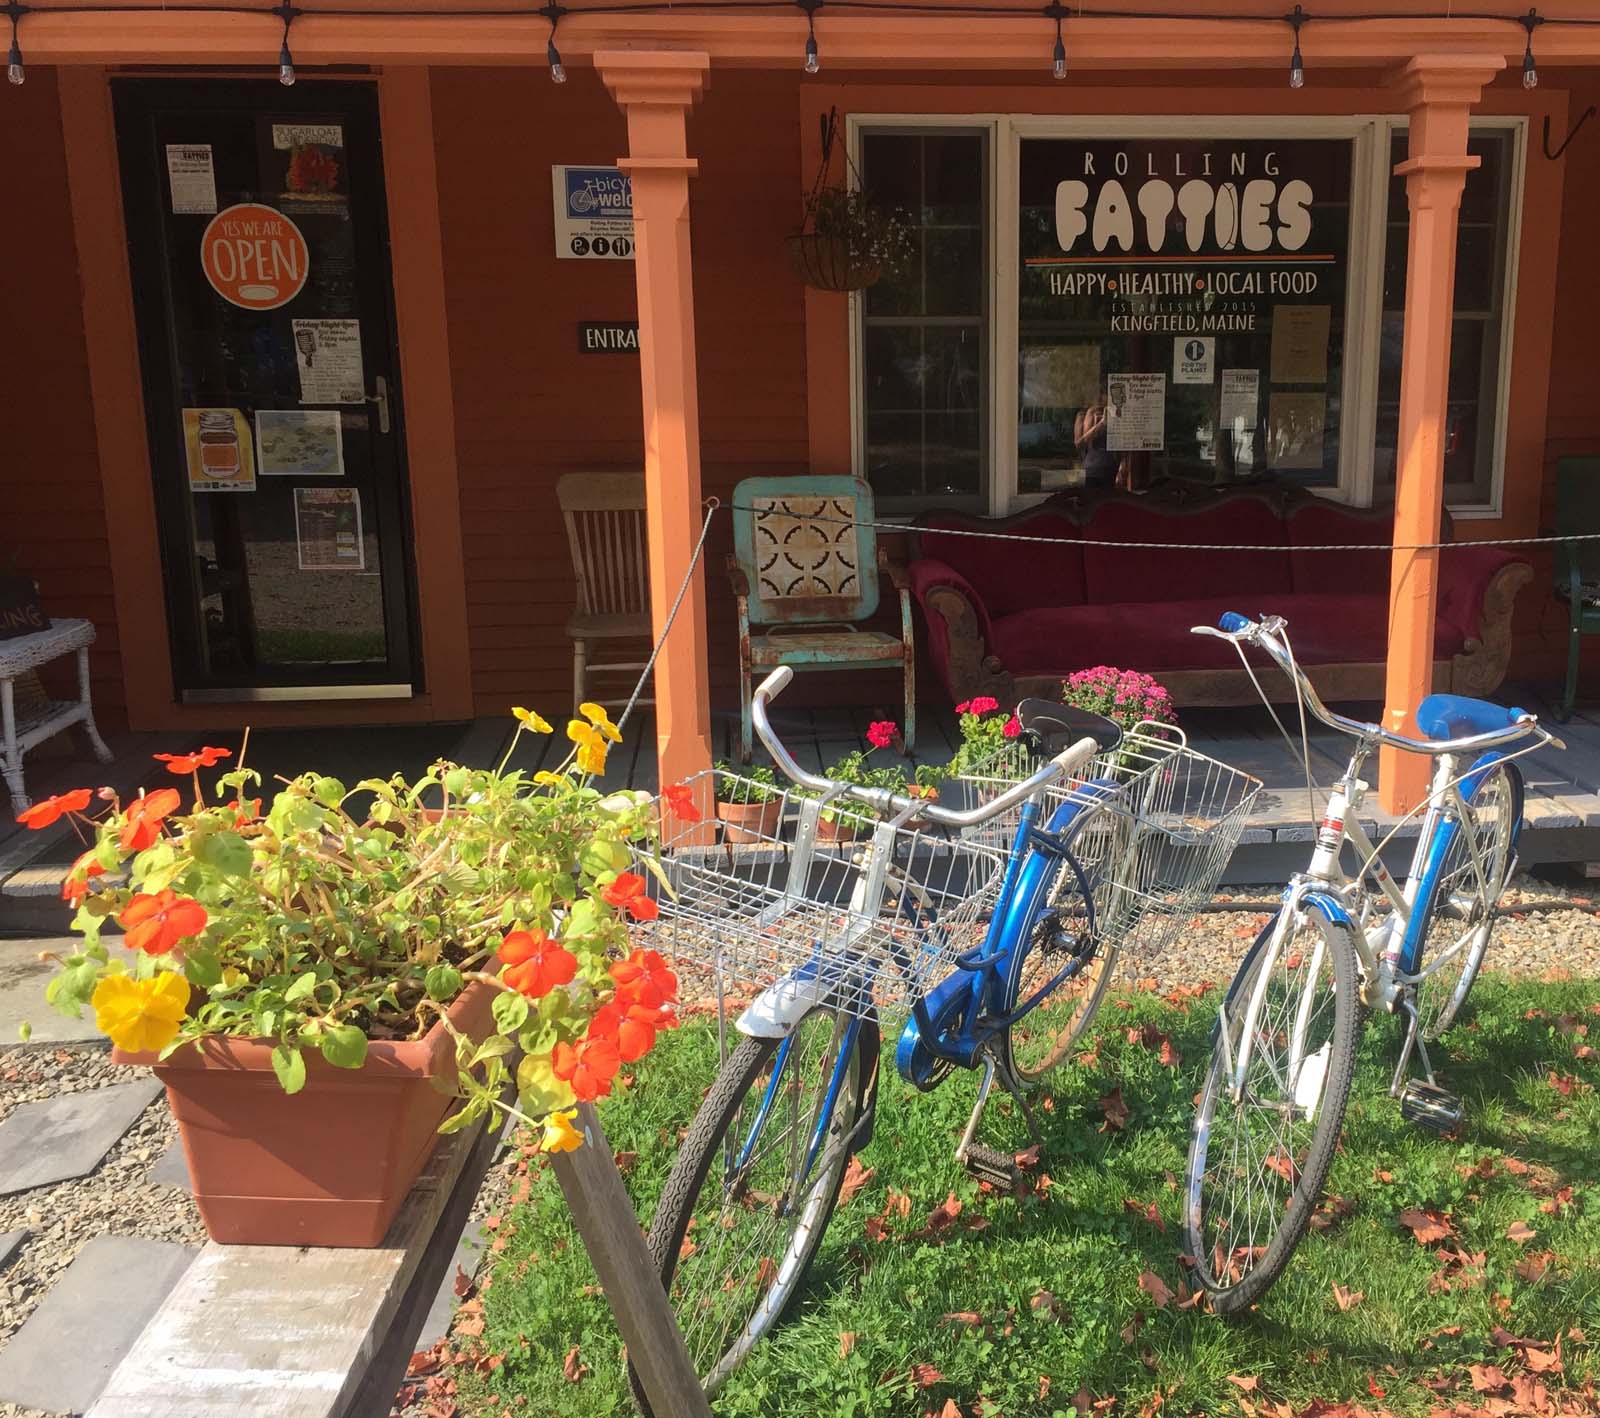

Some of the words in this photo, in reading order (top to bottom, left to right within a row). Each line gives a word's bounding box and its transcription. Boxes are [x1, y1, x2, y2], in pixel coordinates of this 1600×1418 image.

[1083, 152, 1280, 176] ROLLING
[1055, 179, 1314, 252] FATTIES
[222, 220, 241, 237] YES
[241, 220, 260, 237] WE
[262, 220, 283, 236] ARE
[212, 238, 298, 282] OPEN
[1049, 272, 1107, 296] HAPPY
[1119, 272, 1195, 295] HEALTHY
[1206, 271, 1265, 295] LOCAL
[1270, 271, 1318, 295] FOOD
[1112, 302, 1213, 313] ESTABLISHED
[1223, 301, 1256, 312] 2015
[1111, 315, 1200, 333] KINGFIELD,
[1202, 314, 1256, 331] MAINE
[586, 328, 640, 348] ENTRA
